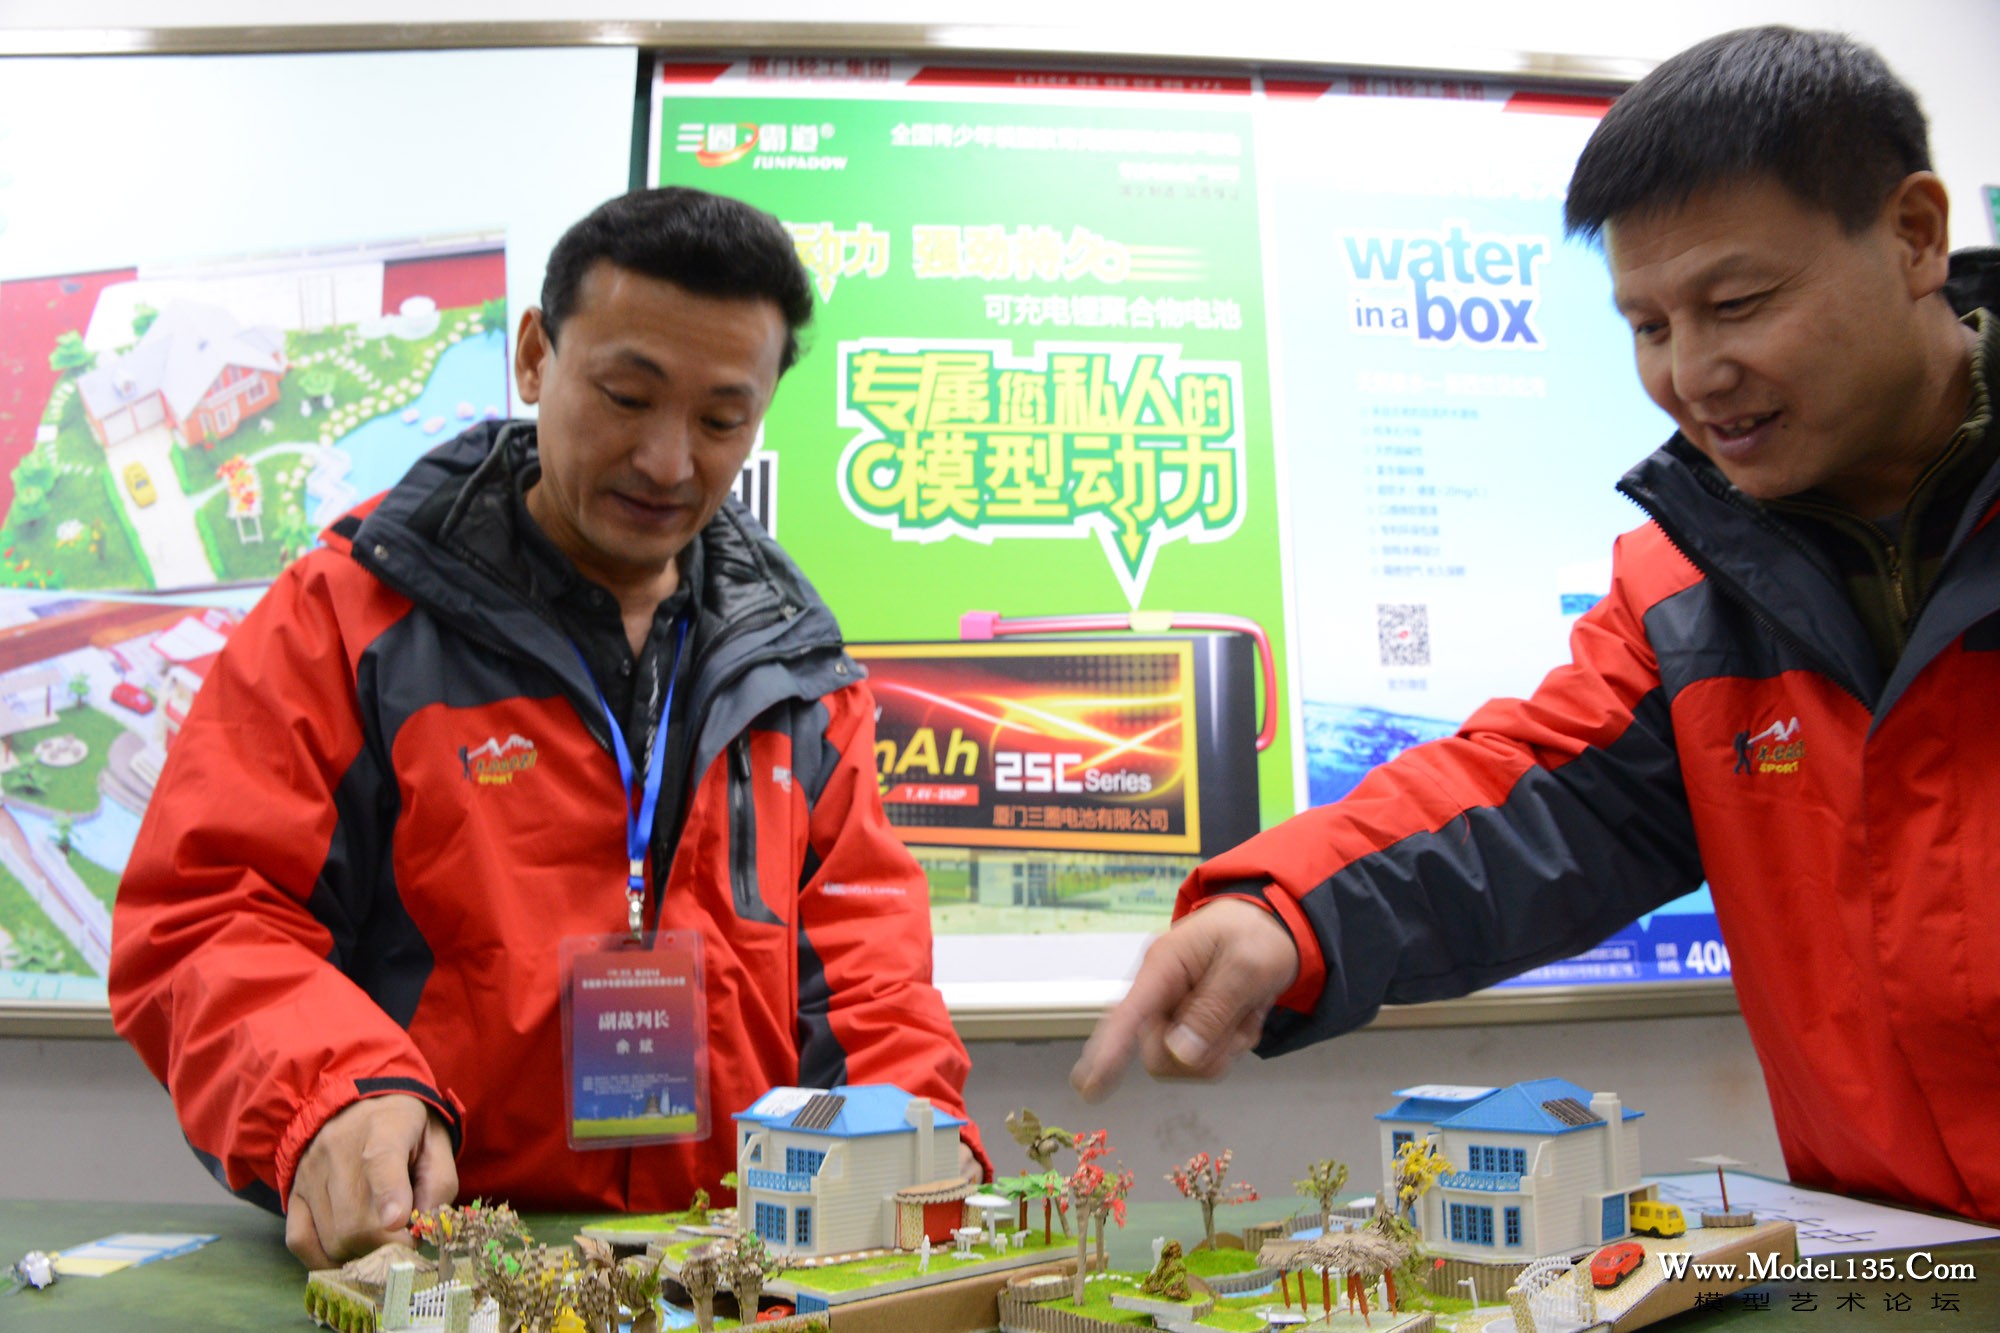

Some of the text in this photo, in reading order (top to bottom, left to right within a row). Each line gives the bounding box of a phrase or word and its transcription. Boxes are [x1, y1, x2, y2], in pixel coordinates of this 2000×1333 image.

[1343, 226, 1544, 286] water
[1355, 276, 1538, 343] in a box
[851, 350, 1234, 436] 专属您私人的
[852, 432, 1235, 524] 模型动力
[995, 752, 1152, 793] 25C Series
